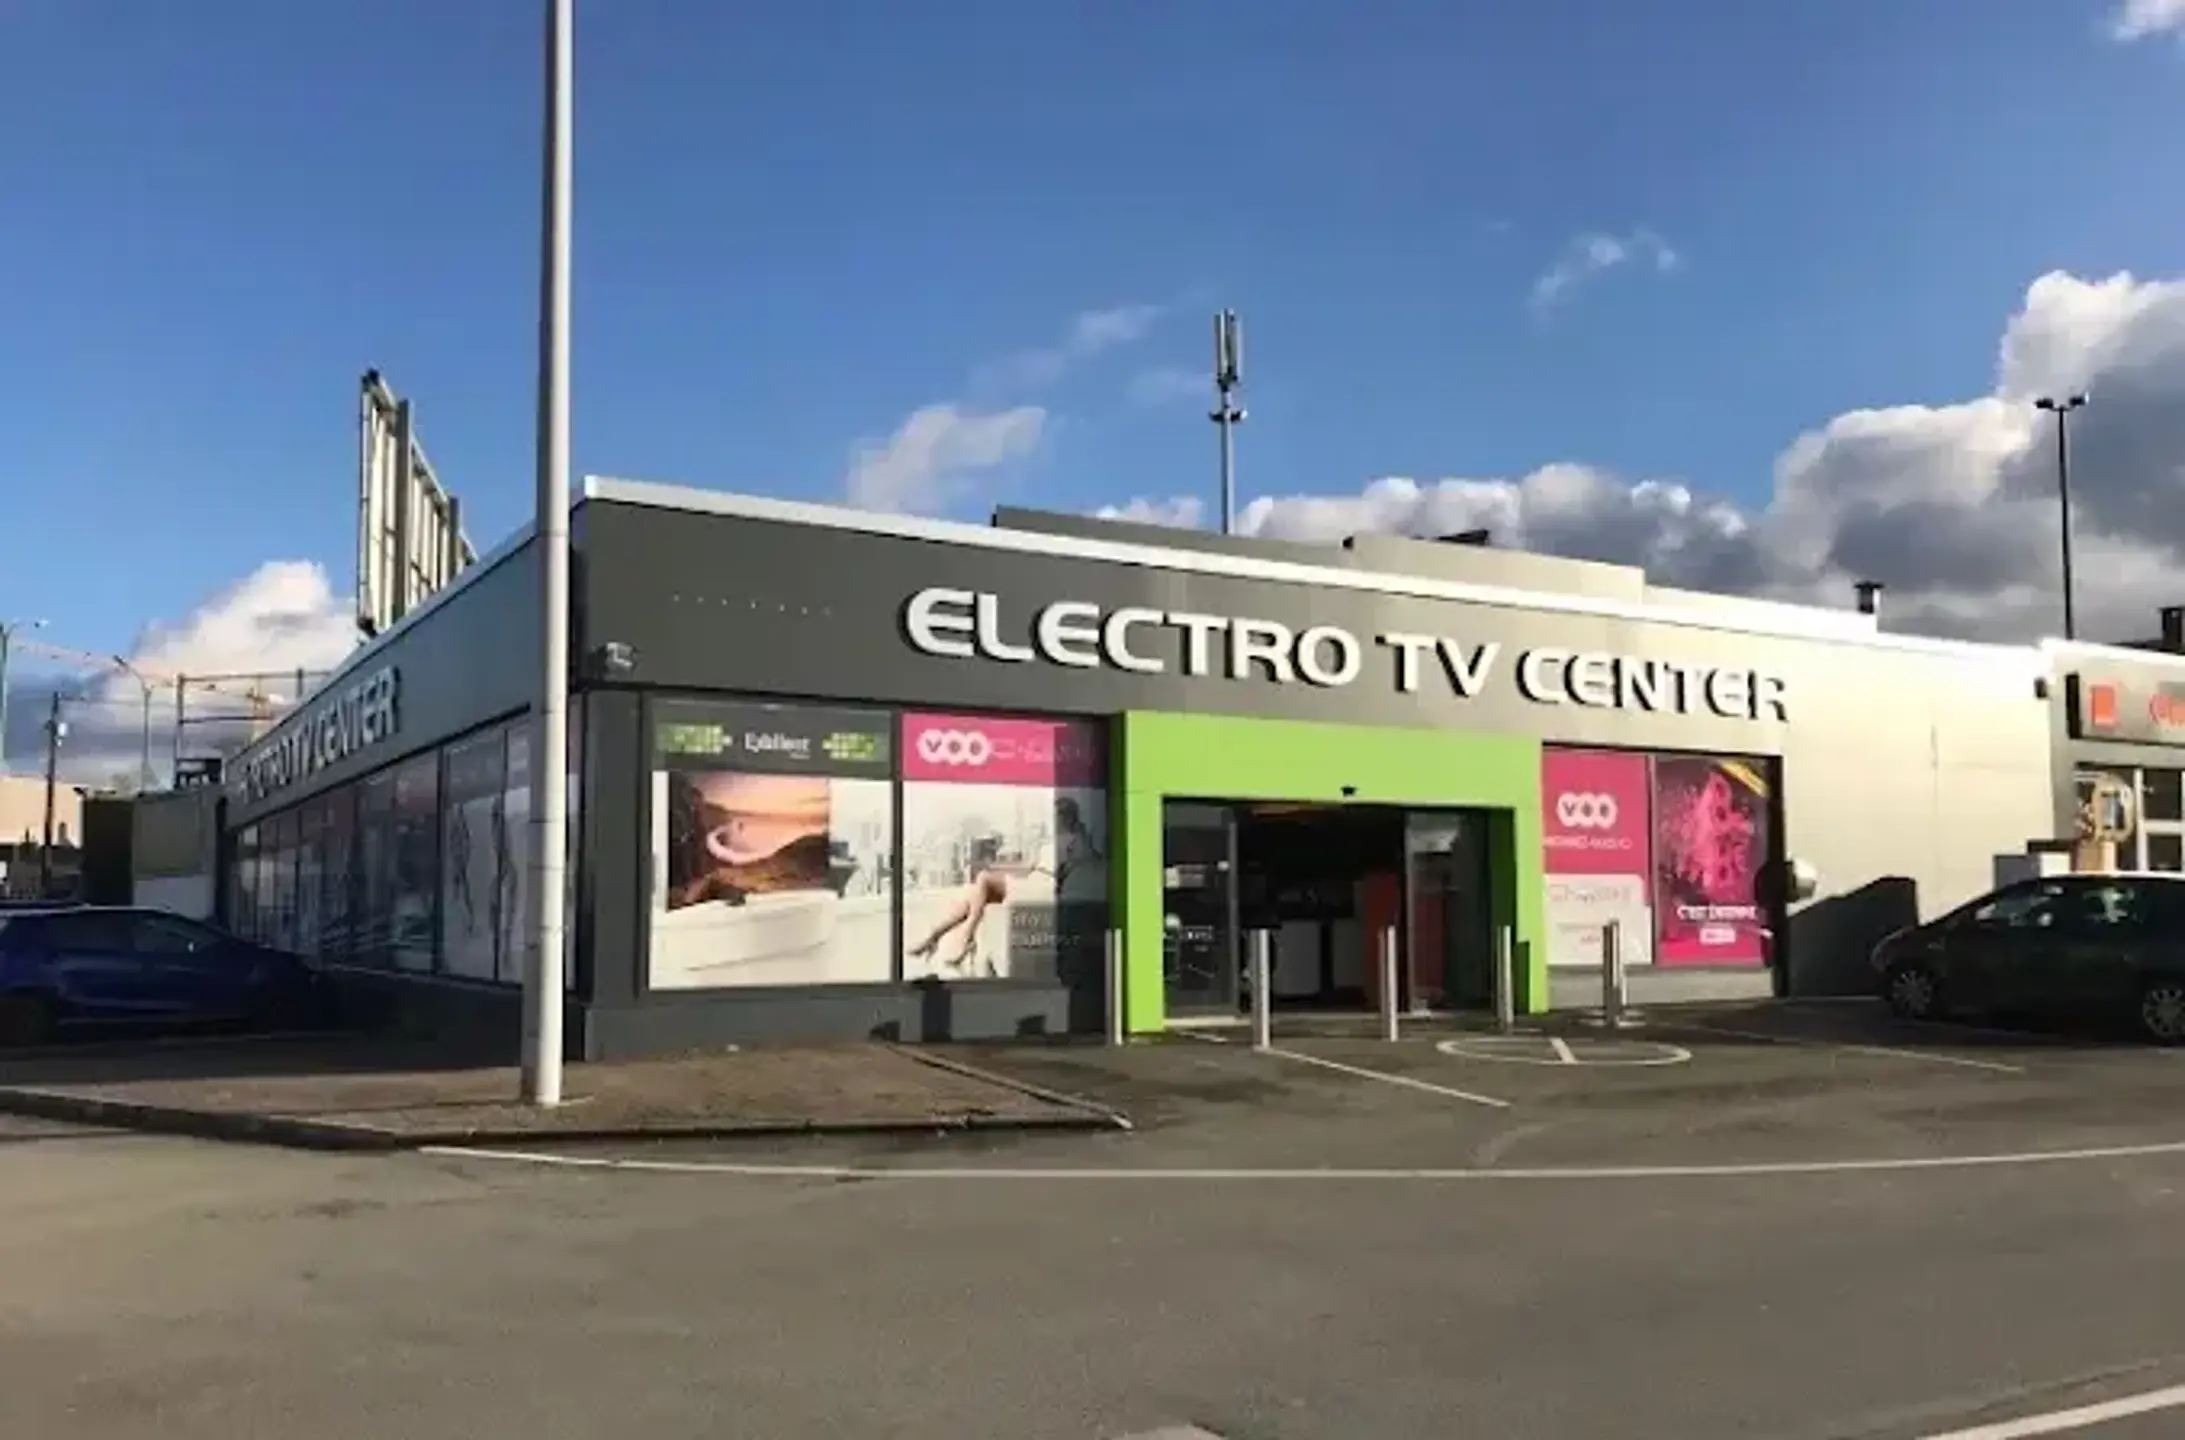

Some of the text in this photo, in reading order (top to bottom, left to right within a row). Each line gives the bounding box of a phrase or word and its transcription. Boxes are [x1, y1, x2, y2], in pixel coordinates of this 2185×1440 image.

[905, 588, 1789, 722] ELECTRO TV CENTER
[315, 666, 396, 769] CENTER
